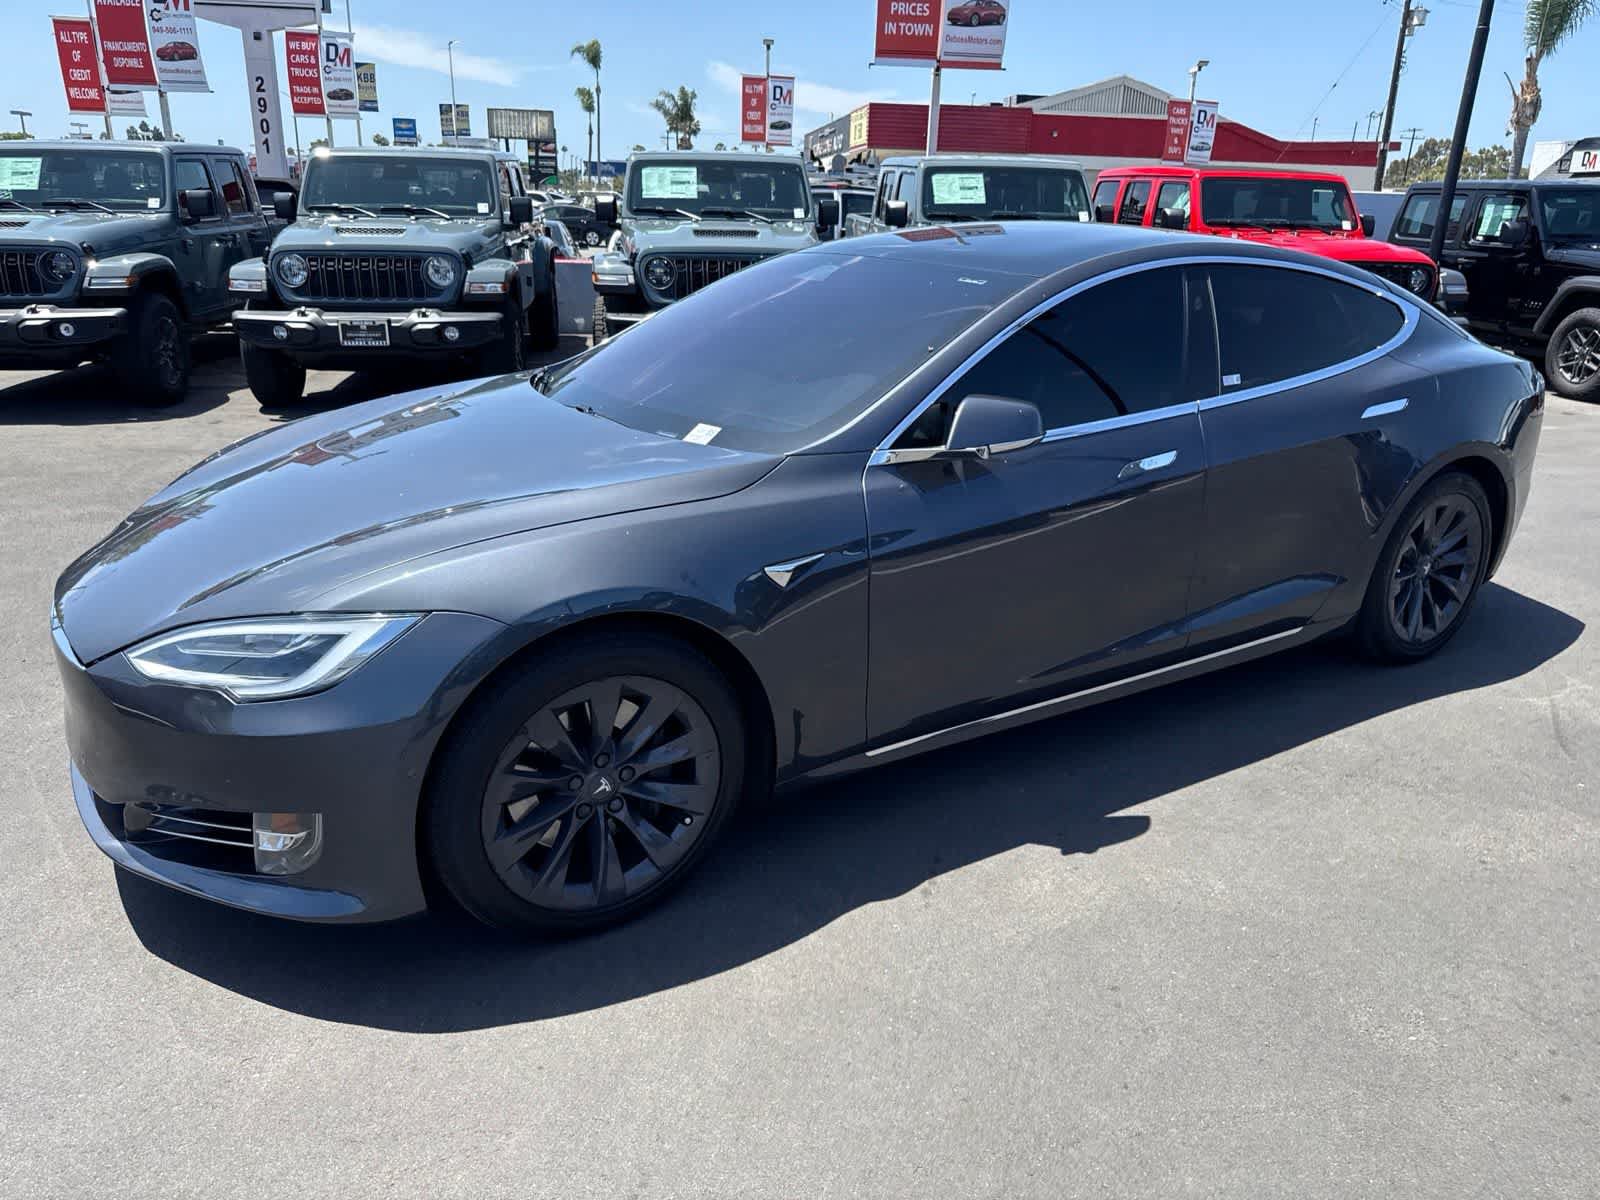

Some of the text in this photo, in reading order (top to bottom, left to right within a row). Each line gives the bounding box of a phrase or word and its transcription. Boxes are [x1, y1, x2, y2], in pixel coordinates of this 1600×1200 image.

[890, 2, 930, 16] PRICES
[884, 21, 934, 36] IN TOWN
[60, 31, 89, 44] ALL TYPE
[288, 41, 316, 51] WE BUY
[72, 50, 82, 62] OF
[290, 54, 316, 64] CARS &
[326, 43, 351, 67] DM
[69, 68, 91, 81] CREDIT
[290, 67, 318, 78] TRUCKS
[68, 87, 100, 100] WELCOME
[293, 85, 319, 94] TRADE-IN
[773, 86, 792, 105] DM
[293, 95, 322, 105] ACCEPTED
[255, 76, 271, 154] 2901
[1197, 109, 1216, 128] DM
